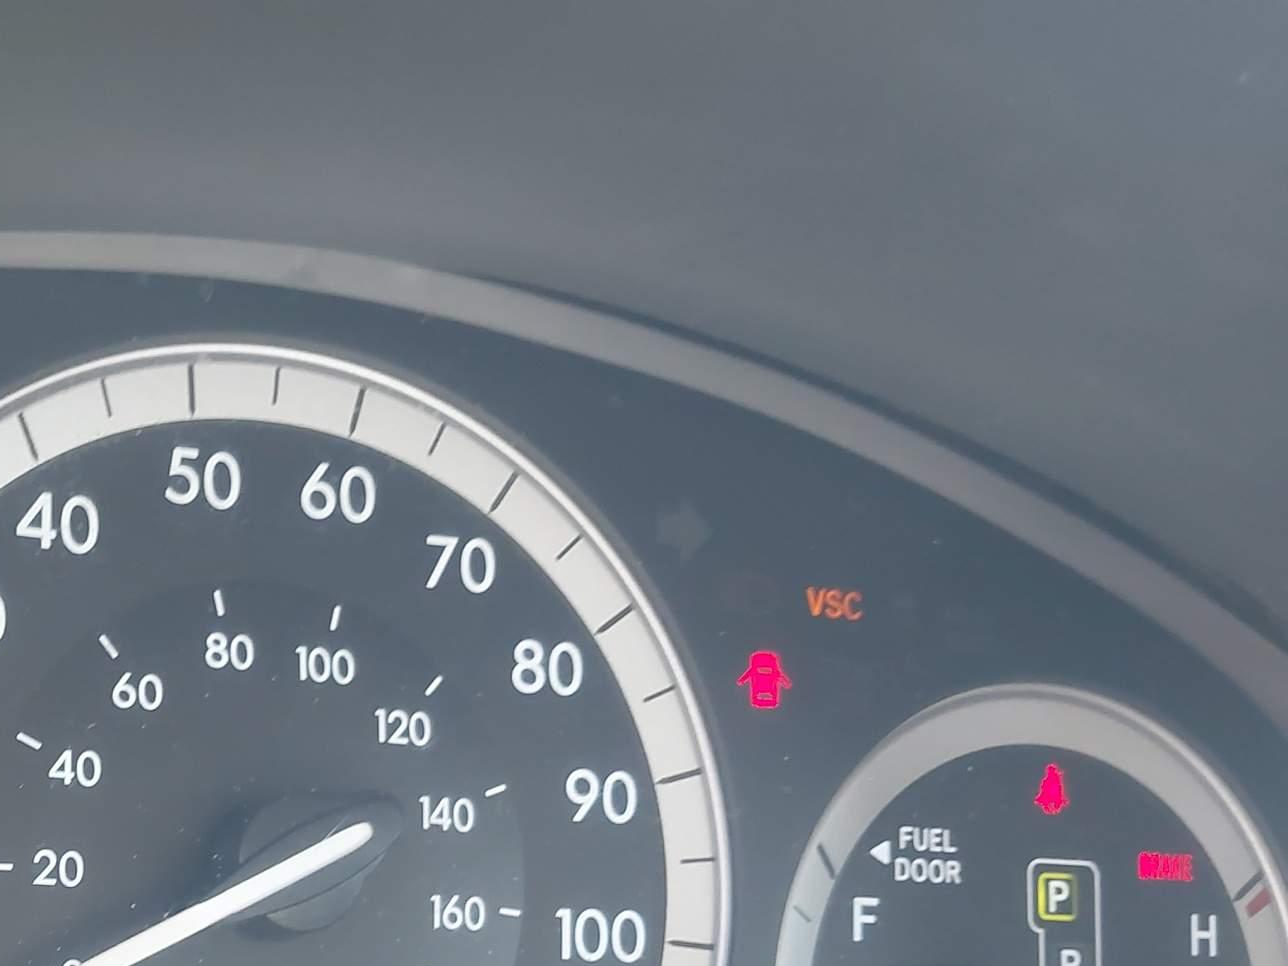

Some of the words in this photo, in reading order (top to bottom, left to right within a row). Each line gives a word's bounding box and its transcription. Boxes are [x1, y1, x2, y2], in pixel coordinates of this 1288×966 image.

[164, 446, 241, 510] 50
[300, 462, 376, 524] 60
[16, 491, 99, 555] 40
[425, 534, 496, 594] 70
[805, 585, 864, 622] VSC
[204, 631, 255, 671] 80
[295, 645, 355, 685] 100
[511, 638, 583, 697] 80
[112, 671, 163, 711] 60
[374, 708, 432, 747] 120
[48, 749, 102, 788] 40
[418, 795, 475, 833] 140
[565, 768, 638, 825] 90
[898, 825, 958, 853] FUEL
[32, 848, 84, 888] 20
[894, 856, 962, 884] DOOR
[430, 894, 486, 931] 160
[1047, 881, 1071, 914] P
[555, 908, 646, 963] 100
[852, 896, 880, 942] F
[1190, 913, 1218, 958] H
